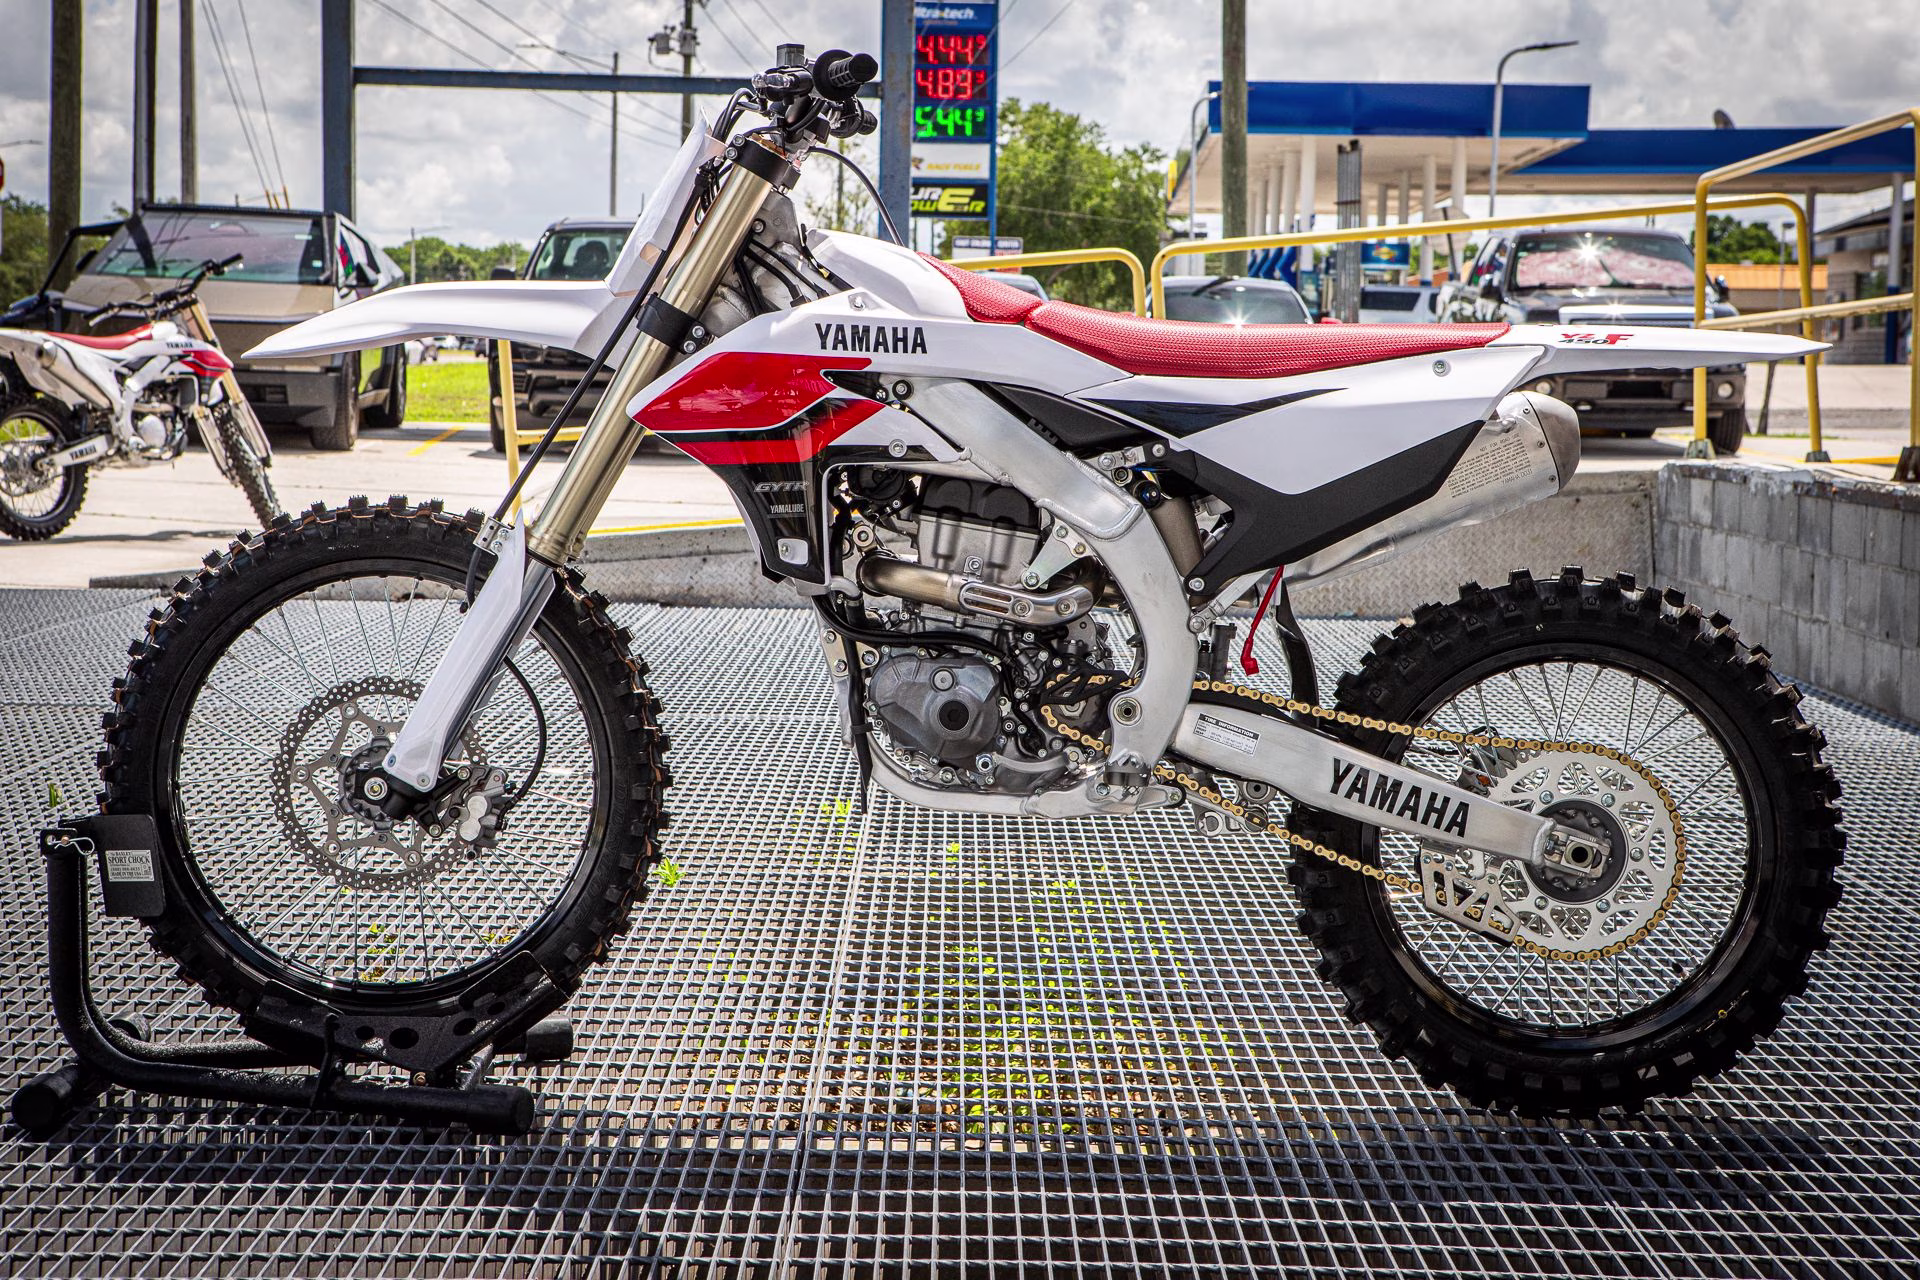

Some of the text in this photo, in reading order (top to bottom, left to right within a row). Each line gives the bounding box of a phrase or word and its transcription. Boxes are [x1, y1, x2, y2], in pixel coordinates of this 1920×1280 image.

[814, 323, 928, 354] YAMAHA
[70, 444, 97, 461] YAMAHA
[754, 481, 807, 492] GYTR
[770, 503, 805, 514] YAMALUBE
[1204, 716, 1217, 724] TIRE
[1218, 721, 1254, 737] INFORMATION
[1330, 757, 1470, 838] YAMAHA
[108, 856, 150, 864] SPORT CHOCK
